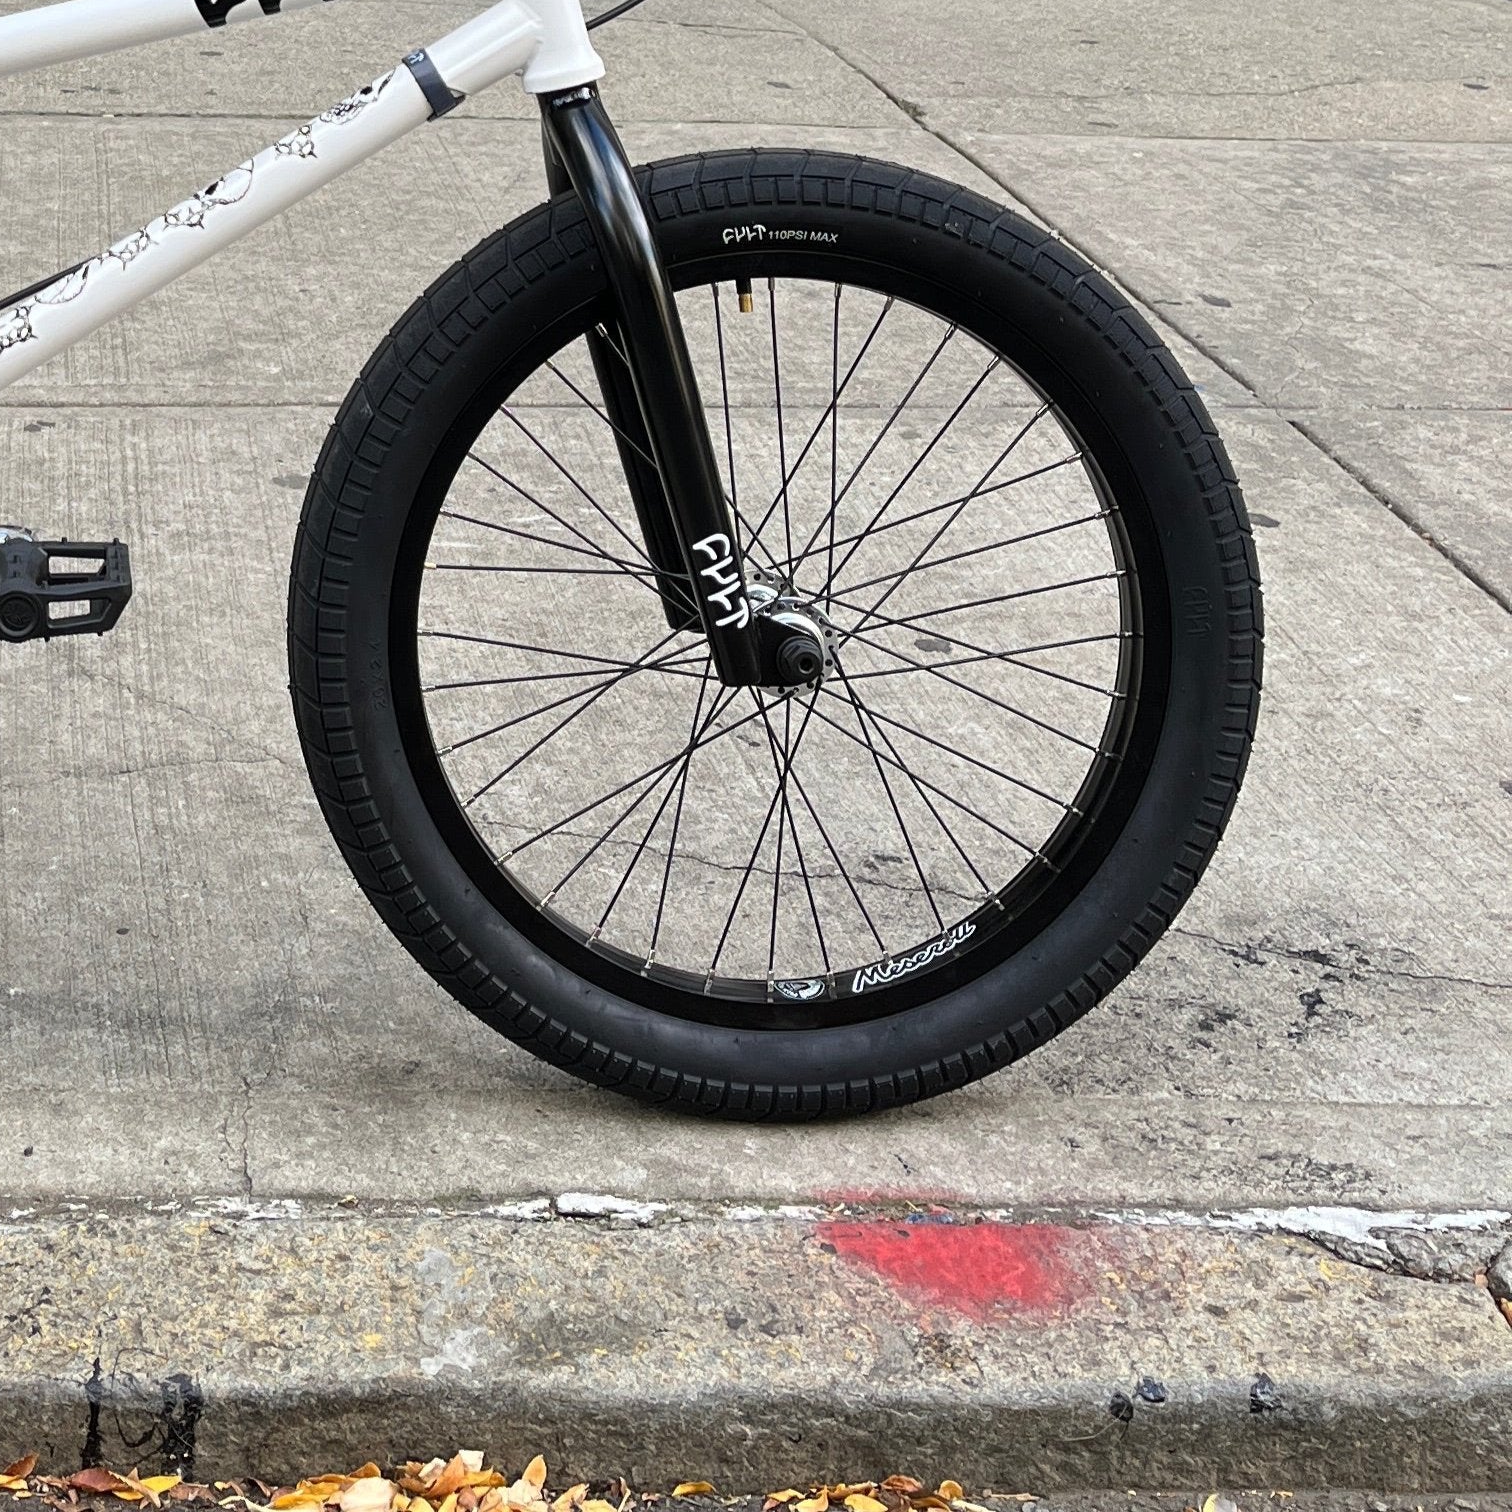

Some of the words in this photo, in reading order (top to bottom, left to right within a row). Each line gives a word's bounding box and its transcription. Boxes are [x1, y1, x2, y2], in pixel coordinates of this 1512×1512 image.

[722, 224, 766, 245] CULT
[768, 230, 808, 241] 110PSI
[810, 231, 839, 244] MAX
[692, 532, 751, 630] CULT
[851, 920, 977, 994] Meseroll
